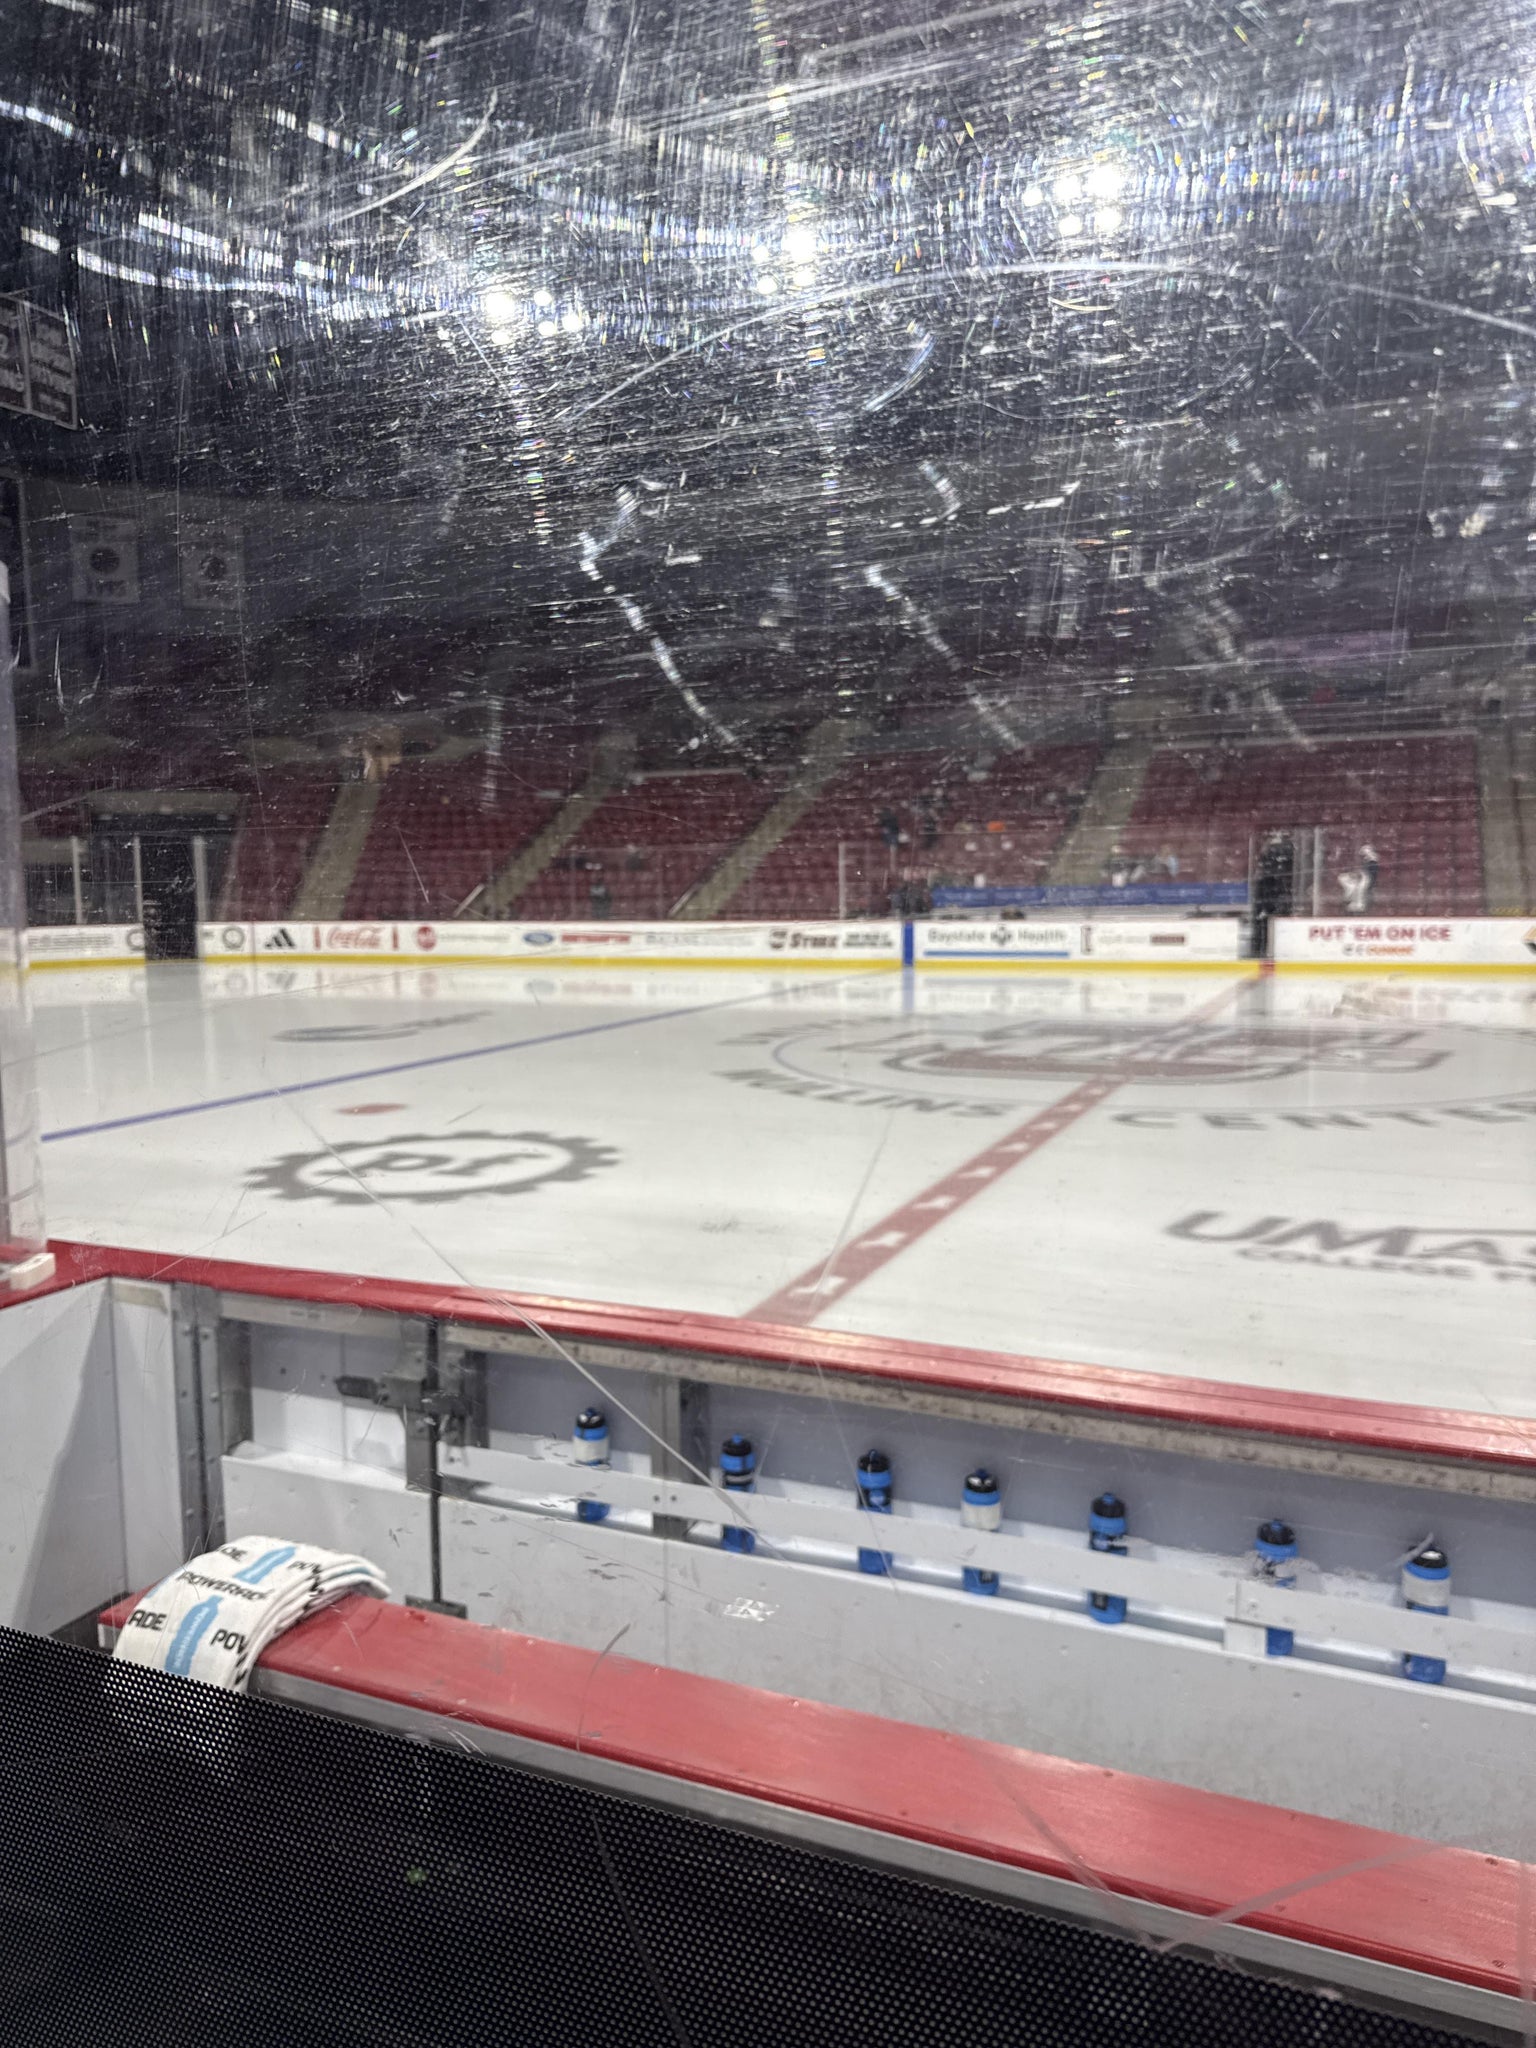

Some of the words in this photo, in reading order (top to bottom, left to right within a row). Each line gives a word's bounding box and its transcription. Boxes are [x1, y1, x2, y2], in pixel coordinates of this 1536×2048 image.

[928, 928, 984, 945] Baystate
[1017, 928, 1065, 943] Health
[1308, 925, 1345, 942] PUT
[1386, 925, 1415, 942] ON
[1419, 925, 1451, 942] ICE
[127, 1609, 167, 1631] ADE
